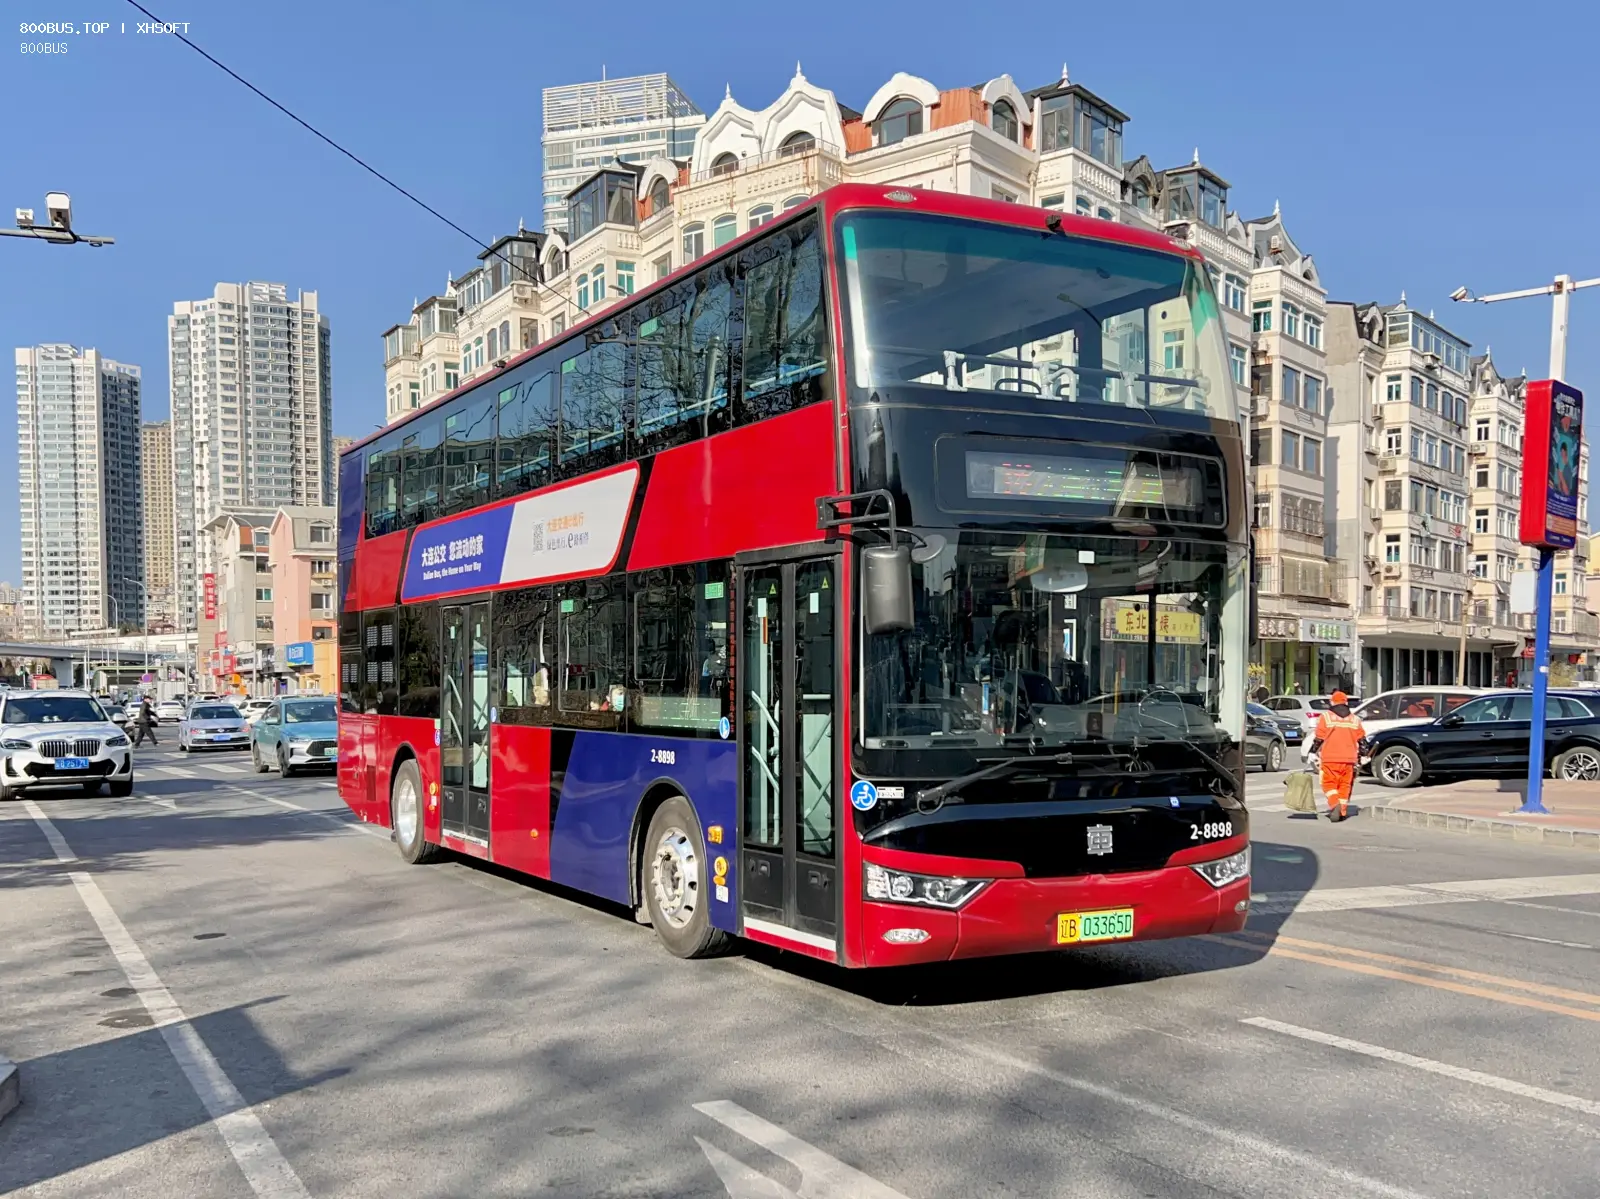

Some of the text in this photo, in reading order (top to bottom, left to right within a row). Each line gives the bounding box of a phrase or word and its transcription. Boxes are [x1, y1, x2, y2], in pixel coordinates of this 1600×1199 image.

[421, 543, 447, 567] 大连公交
[650, 748, 676, 765] 2-8898
[1190, 821, 1233, 840] 2-8898
